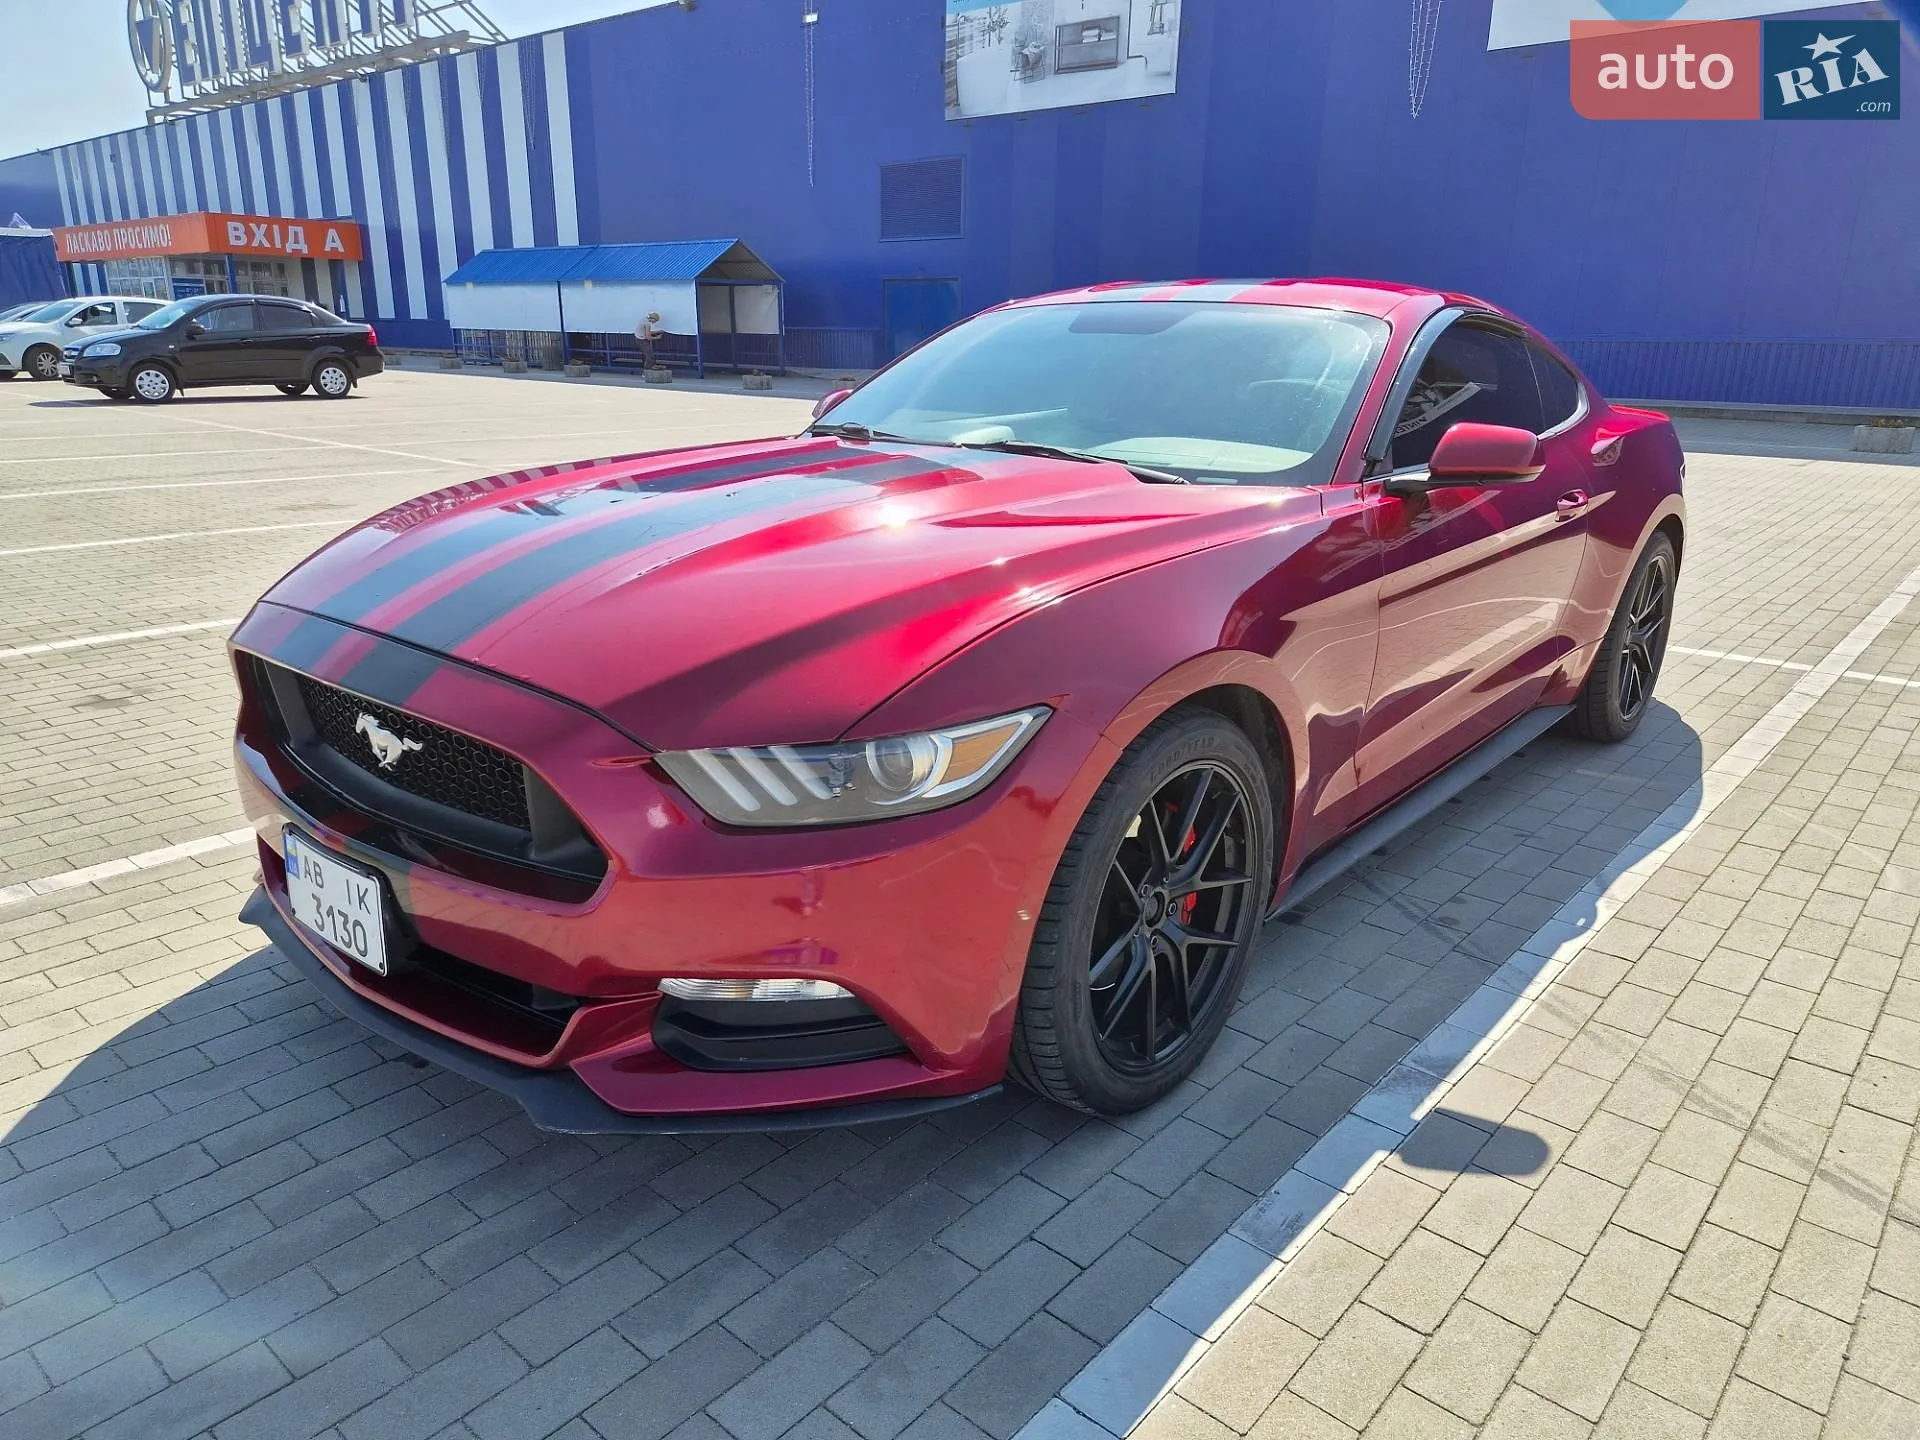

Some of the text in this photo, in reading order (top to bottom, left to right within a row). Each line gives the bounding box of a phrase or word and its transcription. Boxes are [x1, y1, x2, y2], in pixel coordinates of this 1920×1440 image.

[66, 223, 172, 254] ЛАСКАВО ПРОСИМО!
[226, 221, 308, 254] ВХІД
[303, 855, 371, 916] AB IK
[311, 892, 369, 958] 3130
